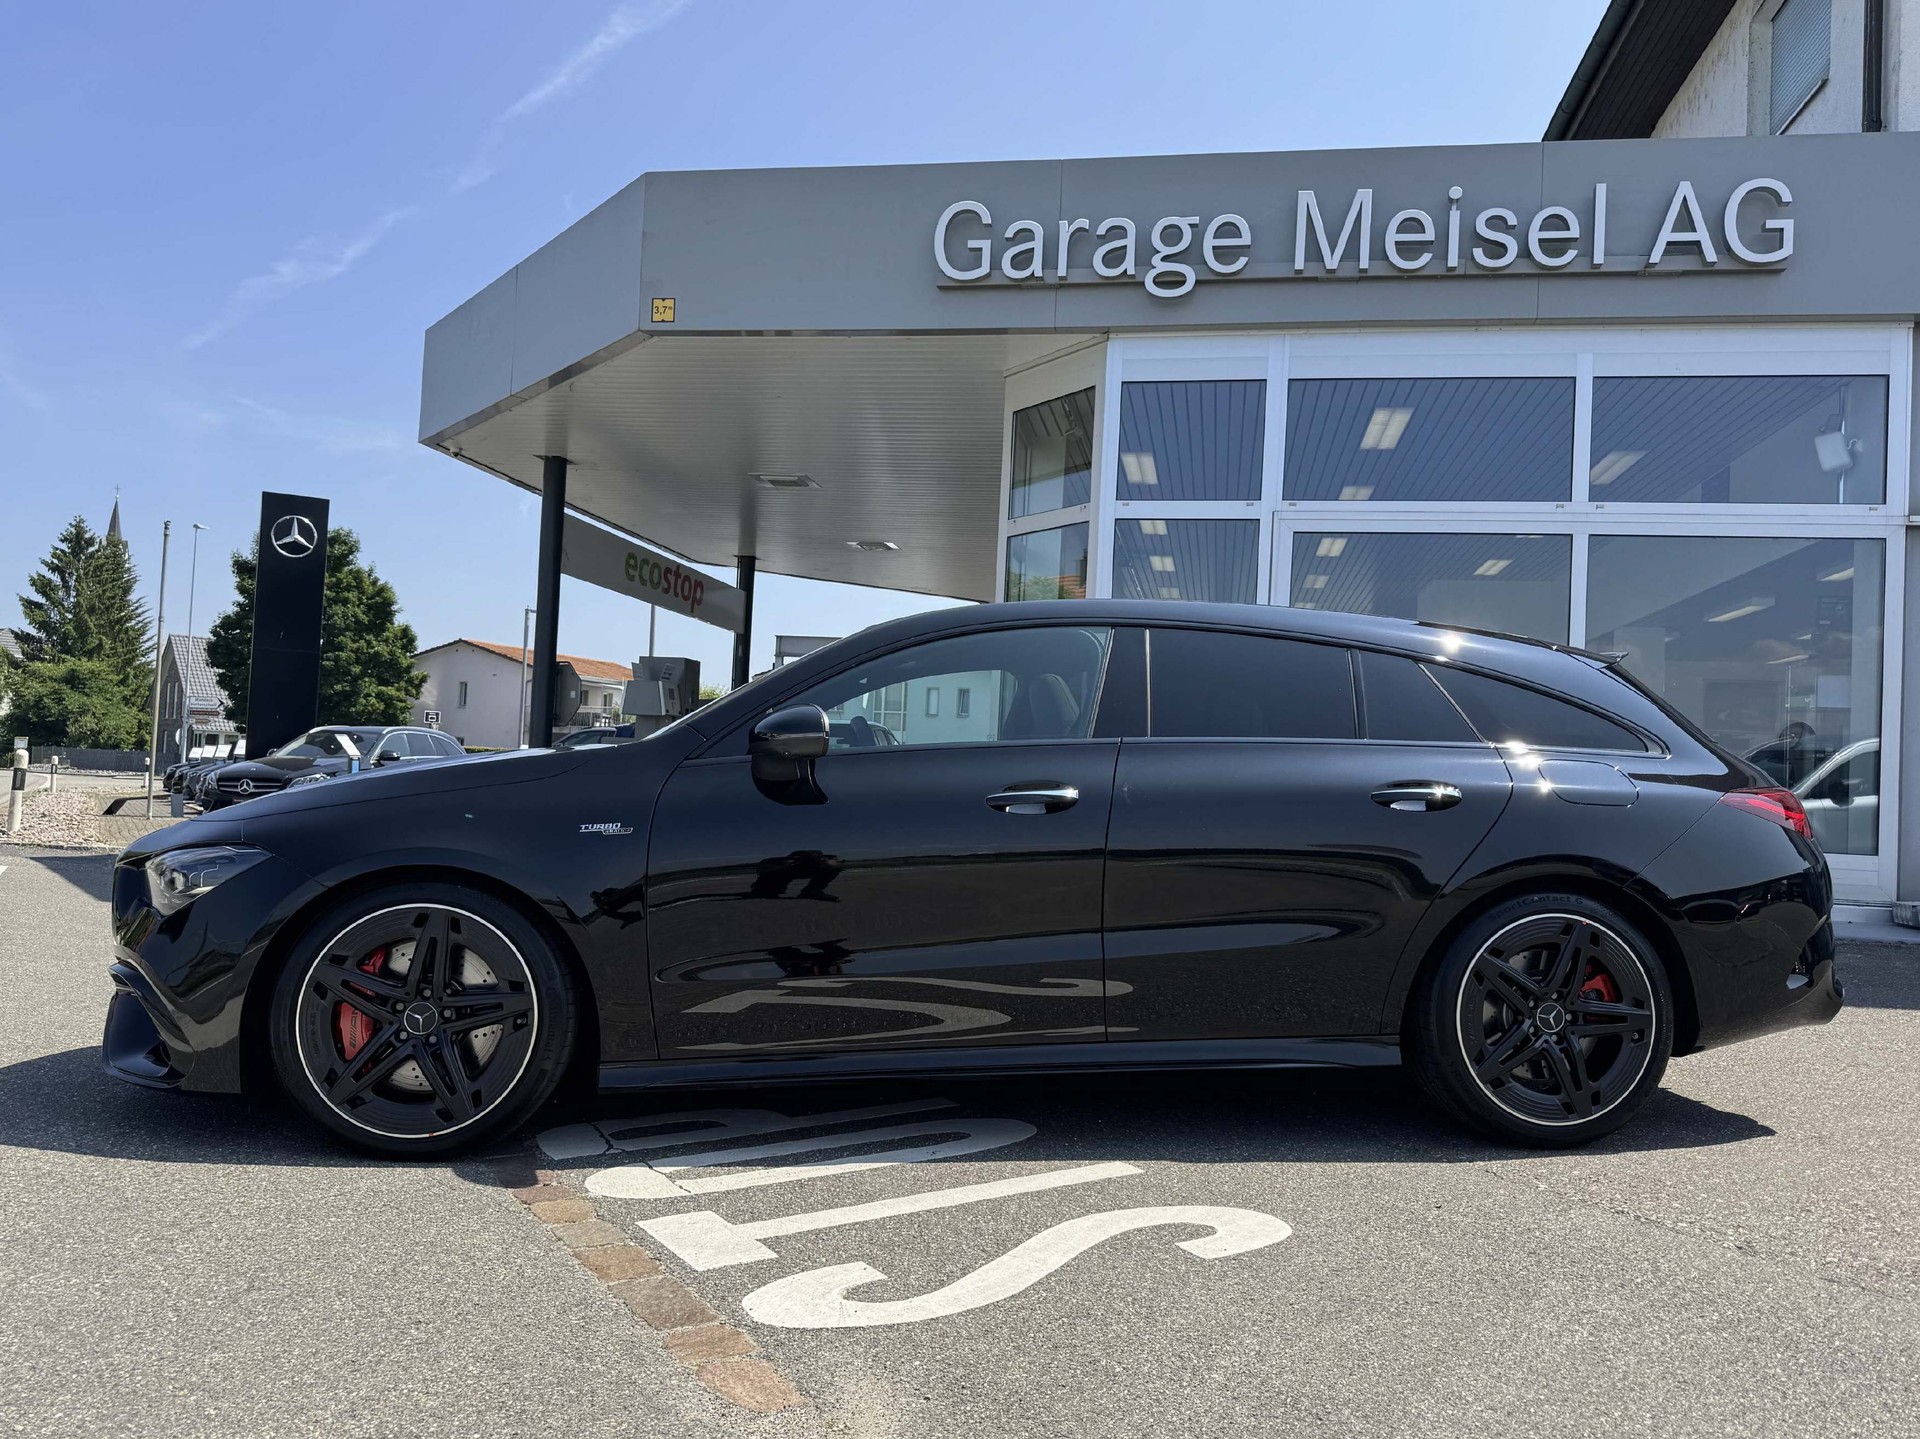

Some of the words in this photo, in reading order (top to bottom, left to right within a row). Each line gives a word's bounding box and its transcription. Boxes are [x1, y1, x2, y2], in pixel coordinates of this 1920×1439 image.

[933, 200, 1251, 298] Garage
[1294, 183, 1607, 275] Meisel
[1648, 177, 1796, 268] AG
[624, 551, 705, 614] ecostop
[579, 822, 621, 831] TURBO
[536, 1097, 1293, 1329] STOP
